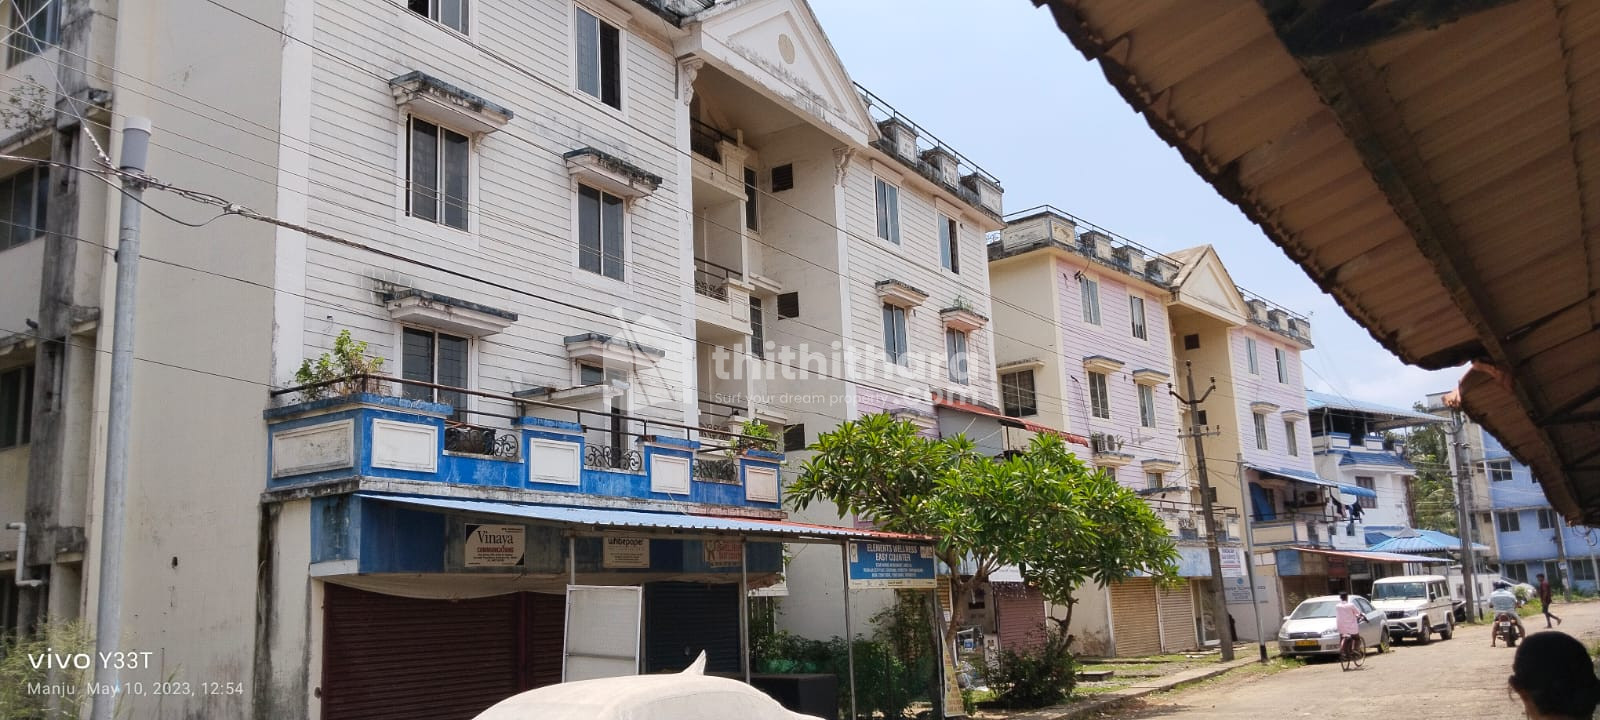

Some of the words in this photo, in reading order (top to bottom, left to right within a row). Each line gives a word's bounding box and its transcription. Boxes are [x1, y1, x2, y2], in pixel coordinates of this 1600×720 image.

[476, 530, 514, 546] Vinaya
[867, 543, 892, 553] ELEMENTS
[889, 553, 911, 562] COUNTER
